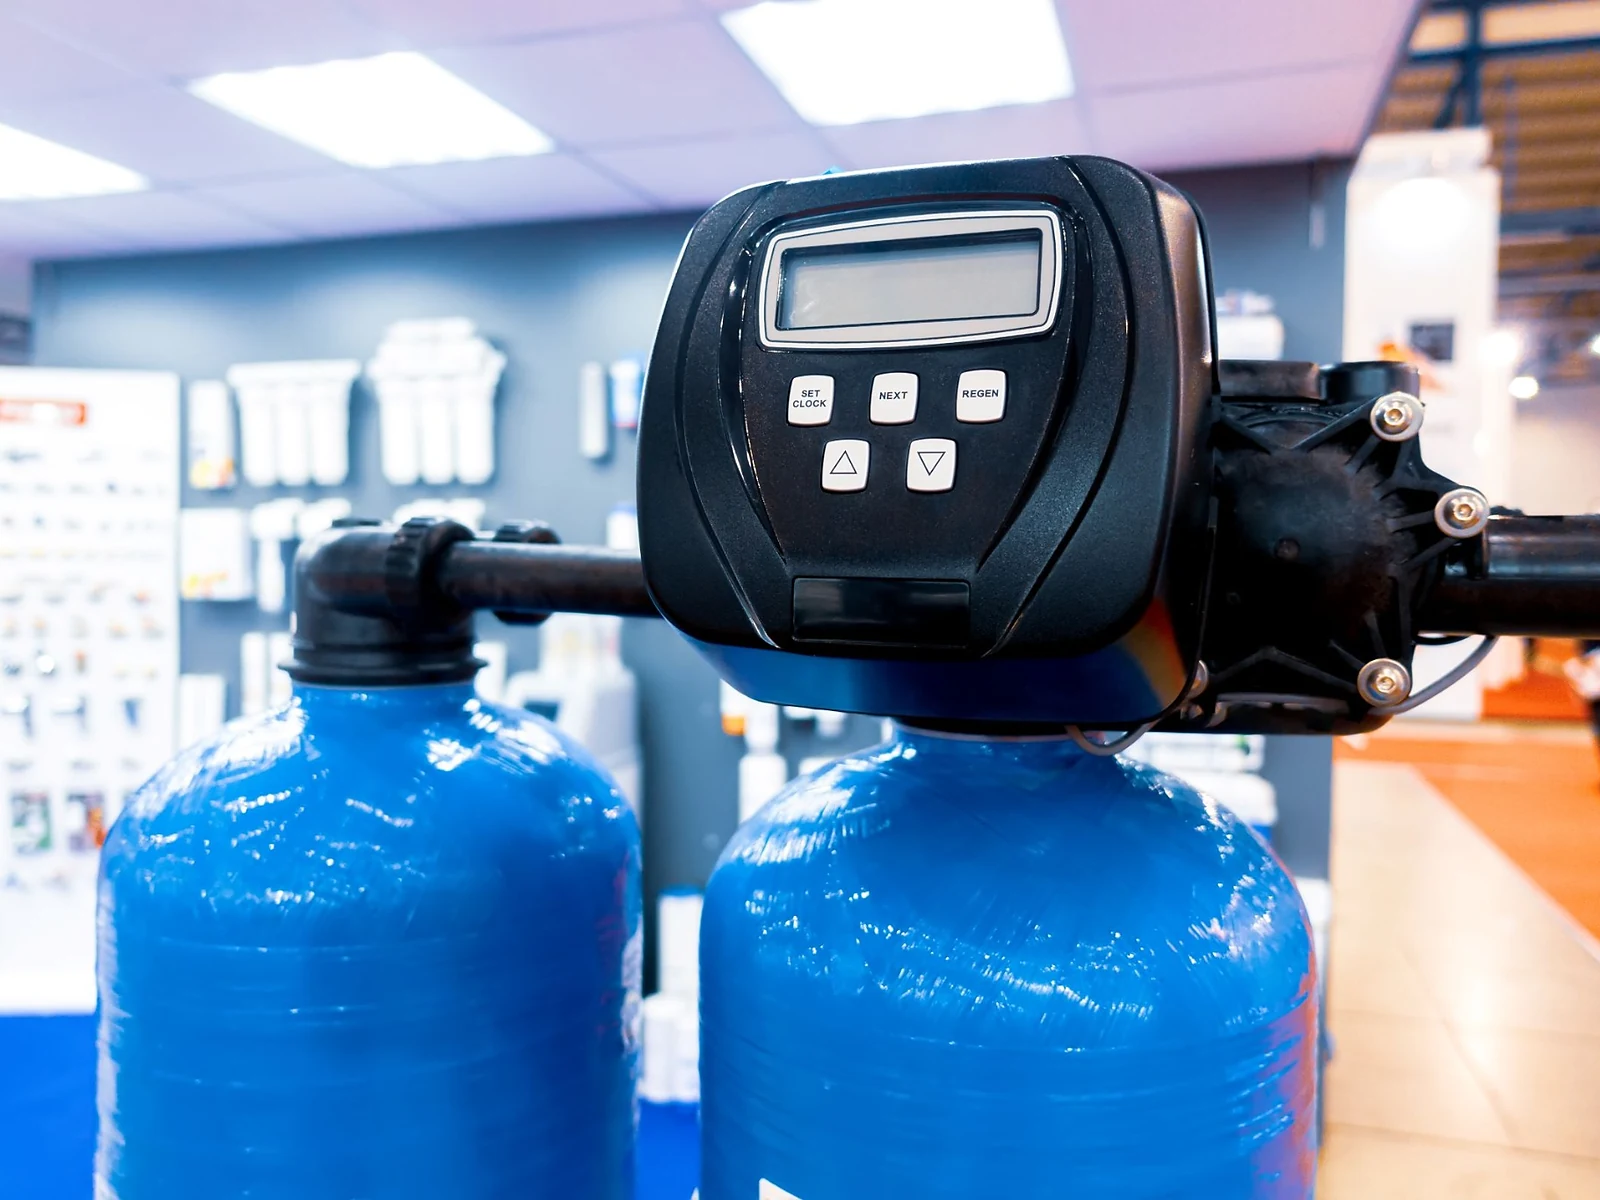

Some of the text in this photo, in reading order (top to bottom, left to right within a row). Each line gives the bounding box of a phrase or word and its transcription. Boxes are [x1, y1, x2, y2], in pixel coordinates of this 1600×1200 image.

[801, 389, 820, 398] SET
[879, 391, 908, 400] NEXT
[962, 389, 999, 398] REGEN
[792, 399, 827, 408] CLOCK
